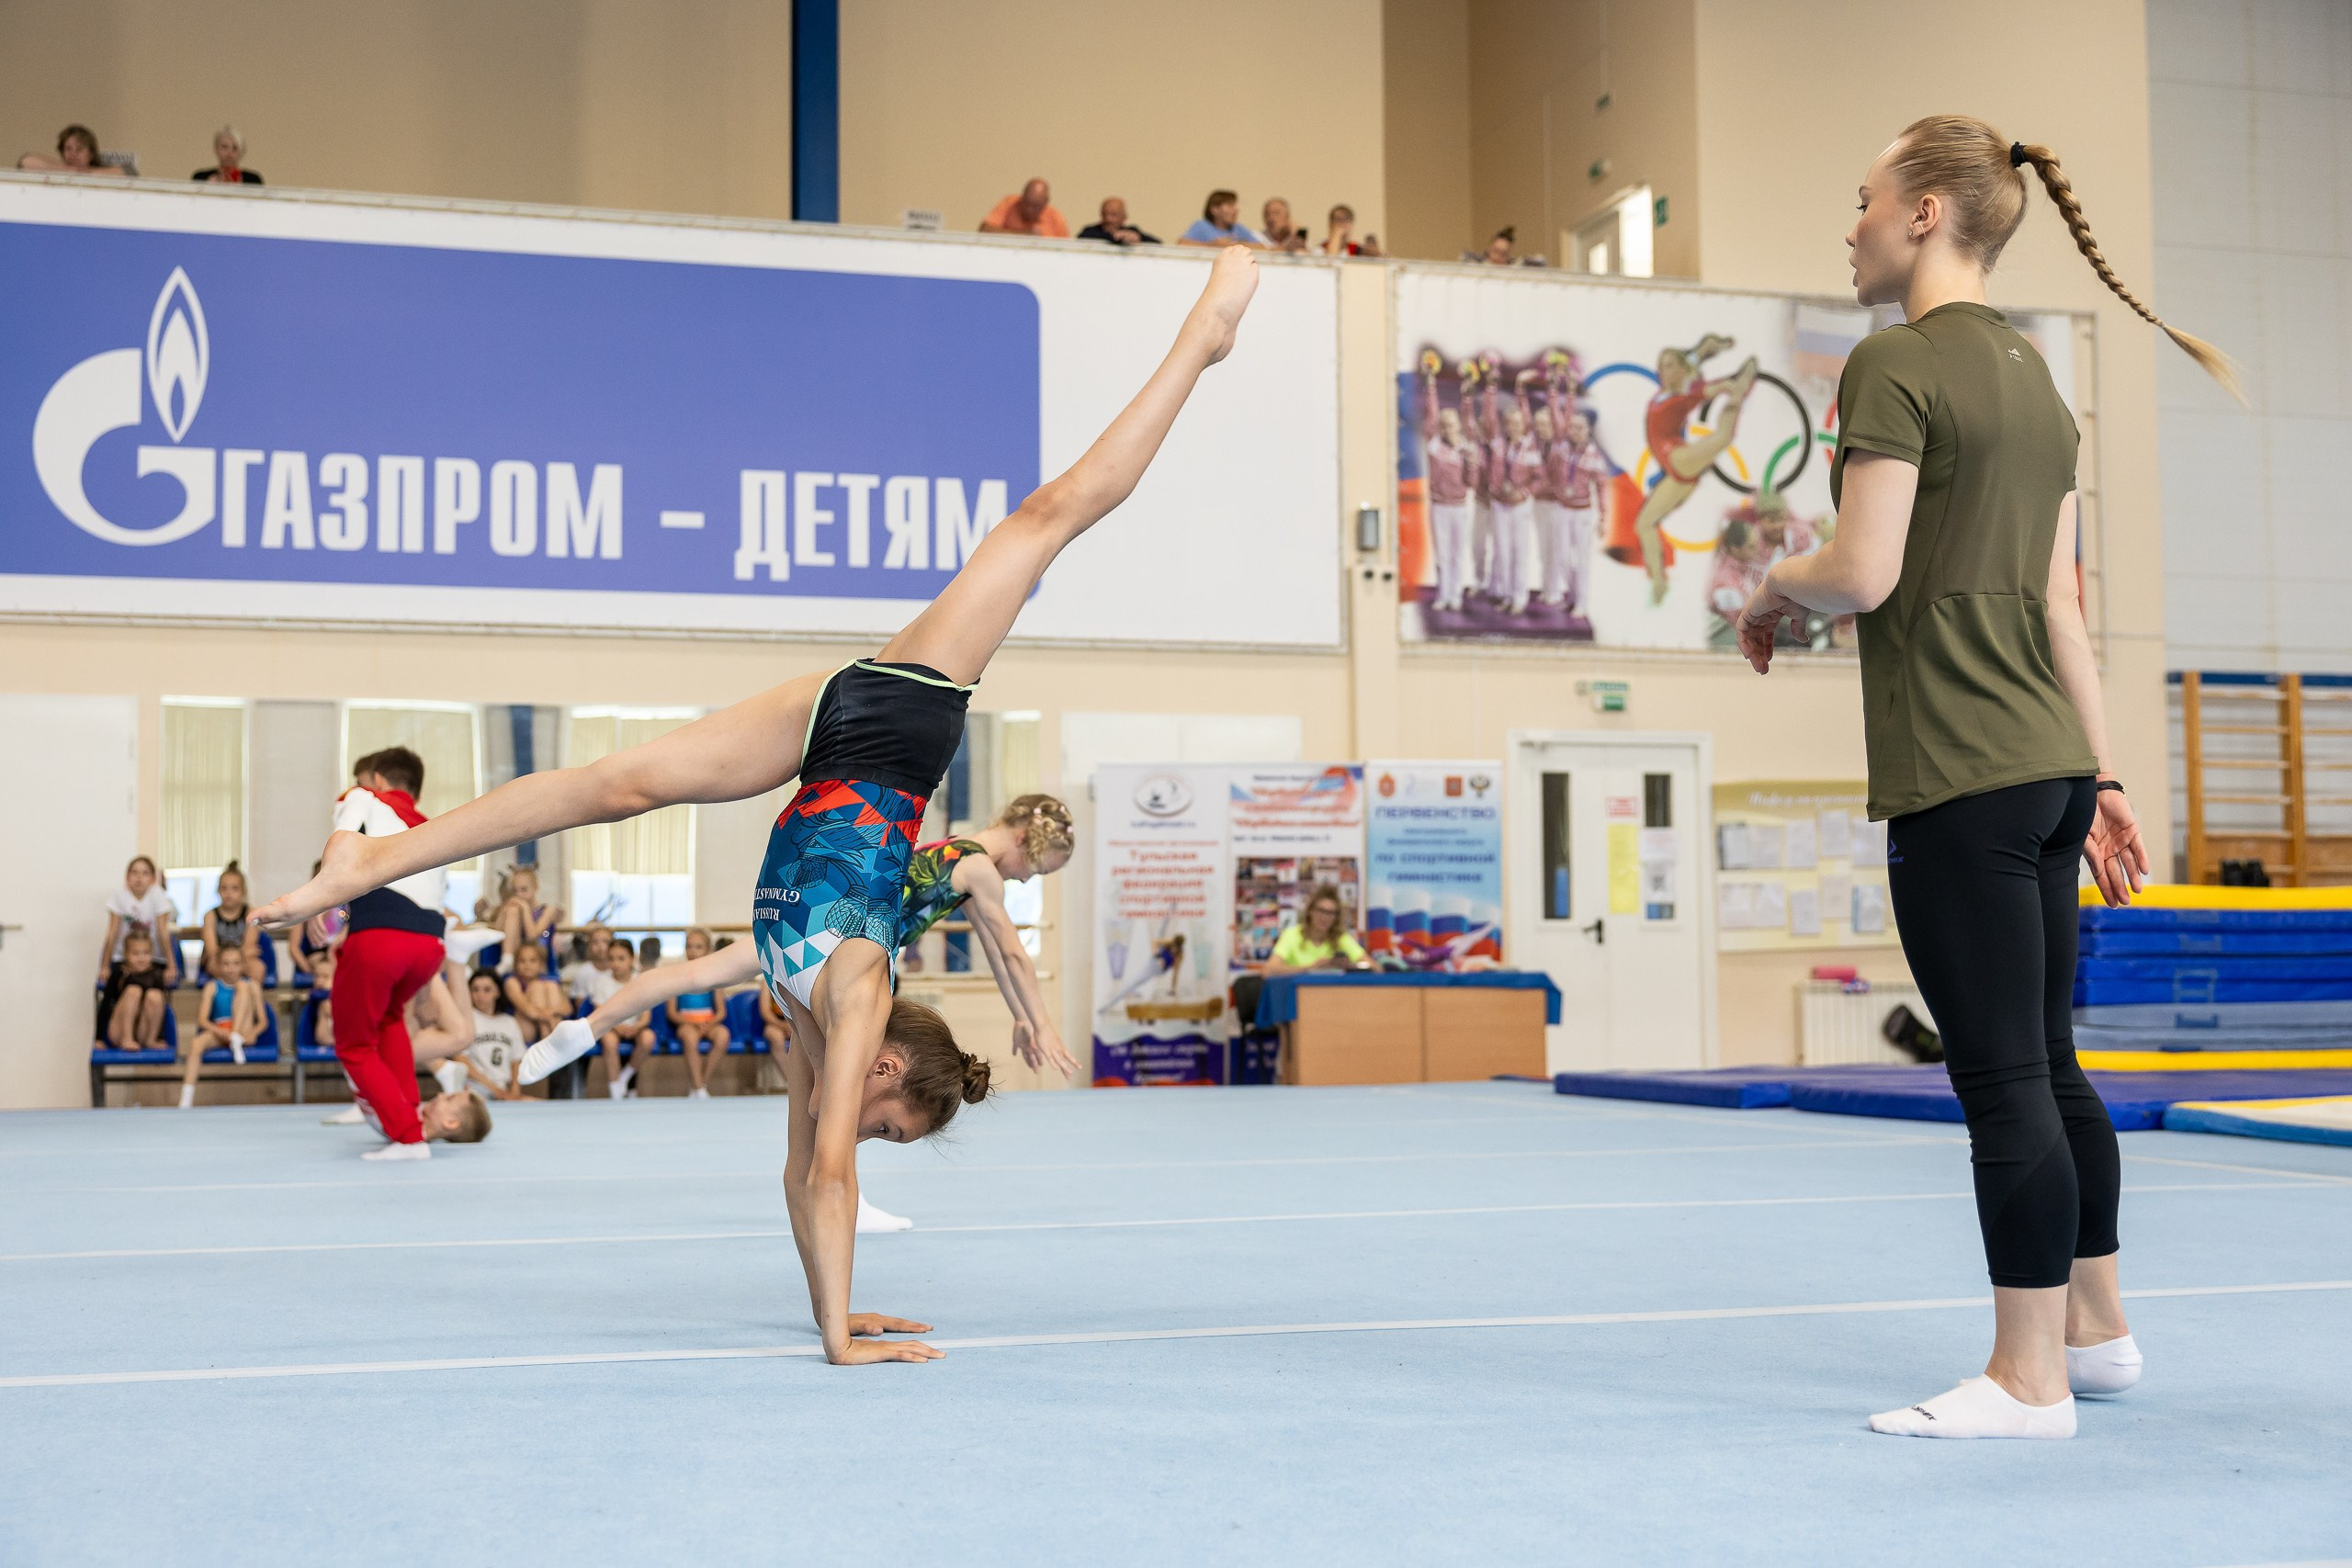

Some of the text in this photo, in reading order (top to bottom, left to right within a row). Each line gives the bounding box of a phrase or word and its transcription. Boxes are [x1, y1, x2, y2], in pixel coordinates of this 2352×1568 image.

[222, 448, 623, 559] ГАЗПРОМ
[734, 468, 1008, 581] ДЕТЯМ
[1375, 807, 1496, 819] ПЕРВЕНСТВО
